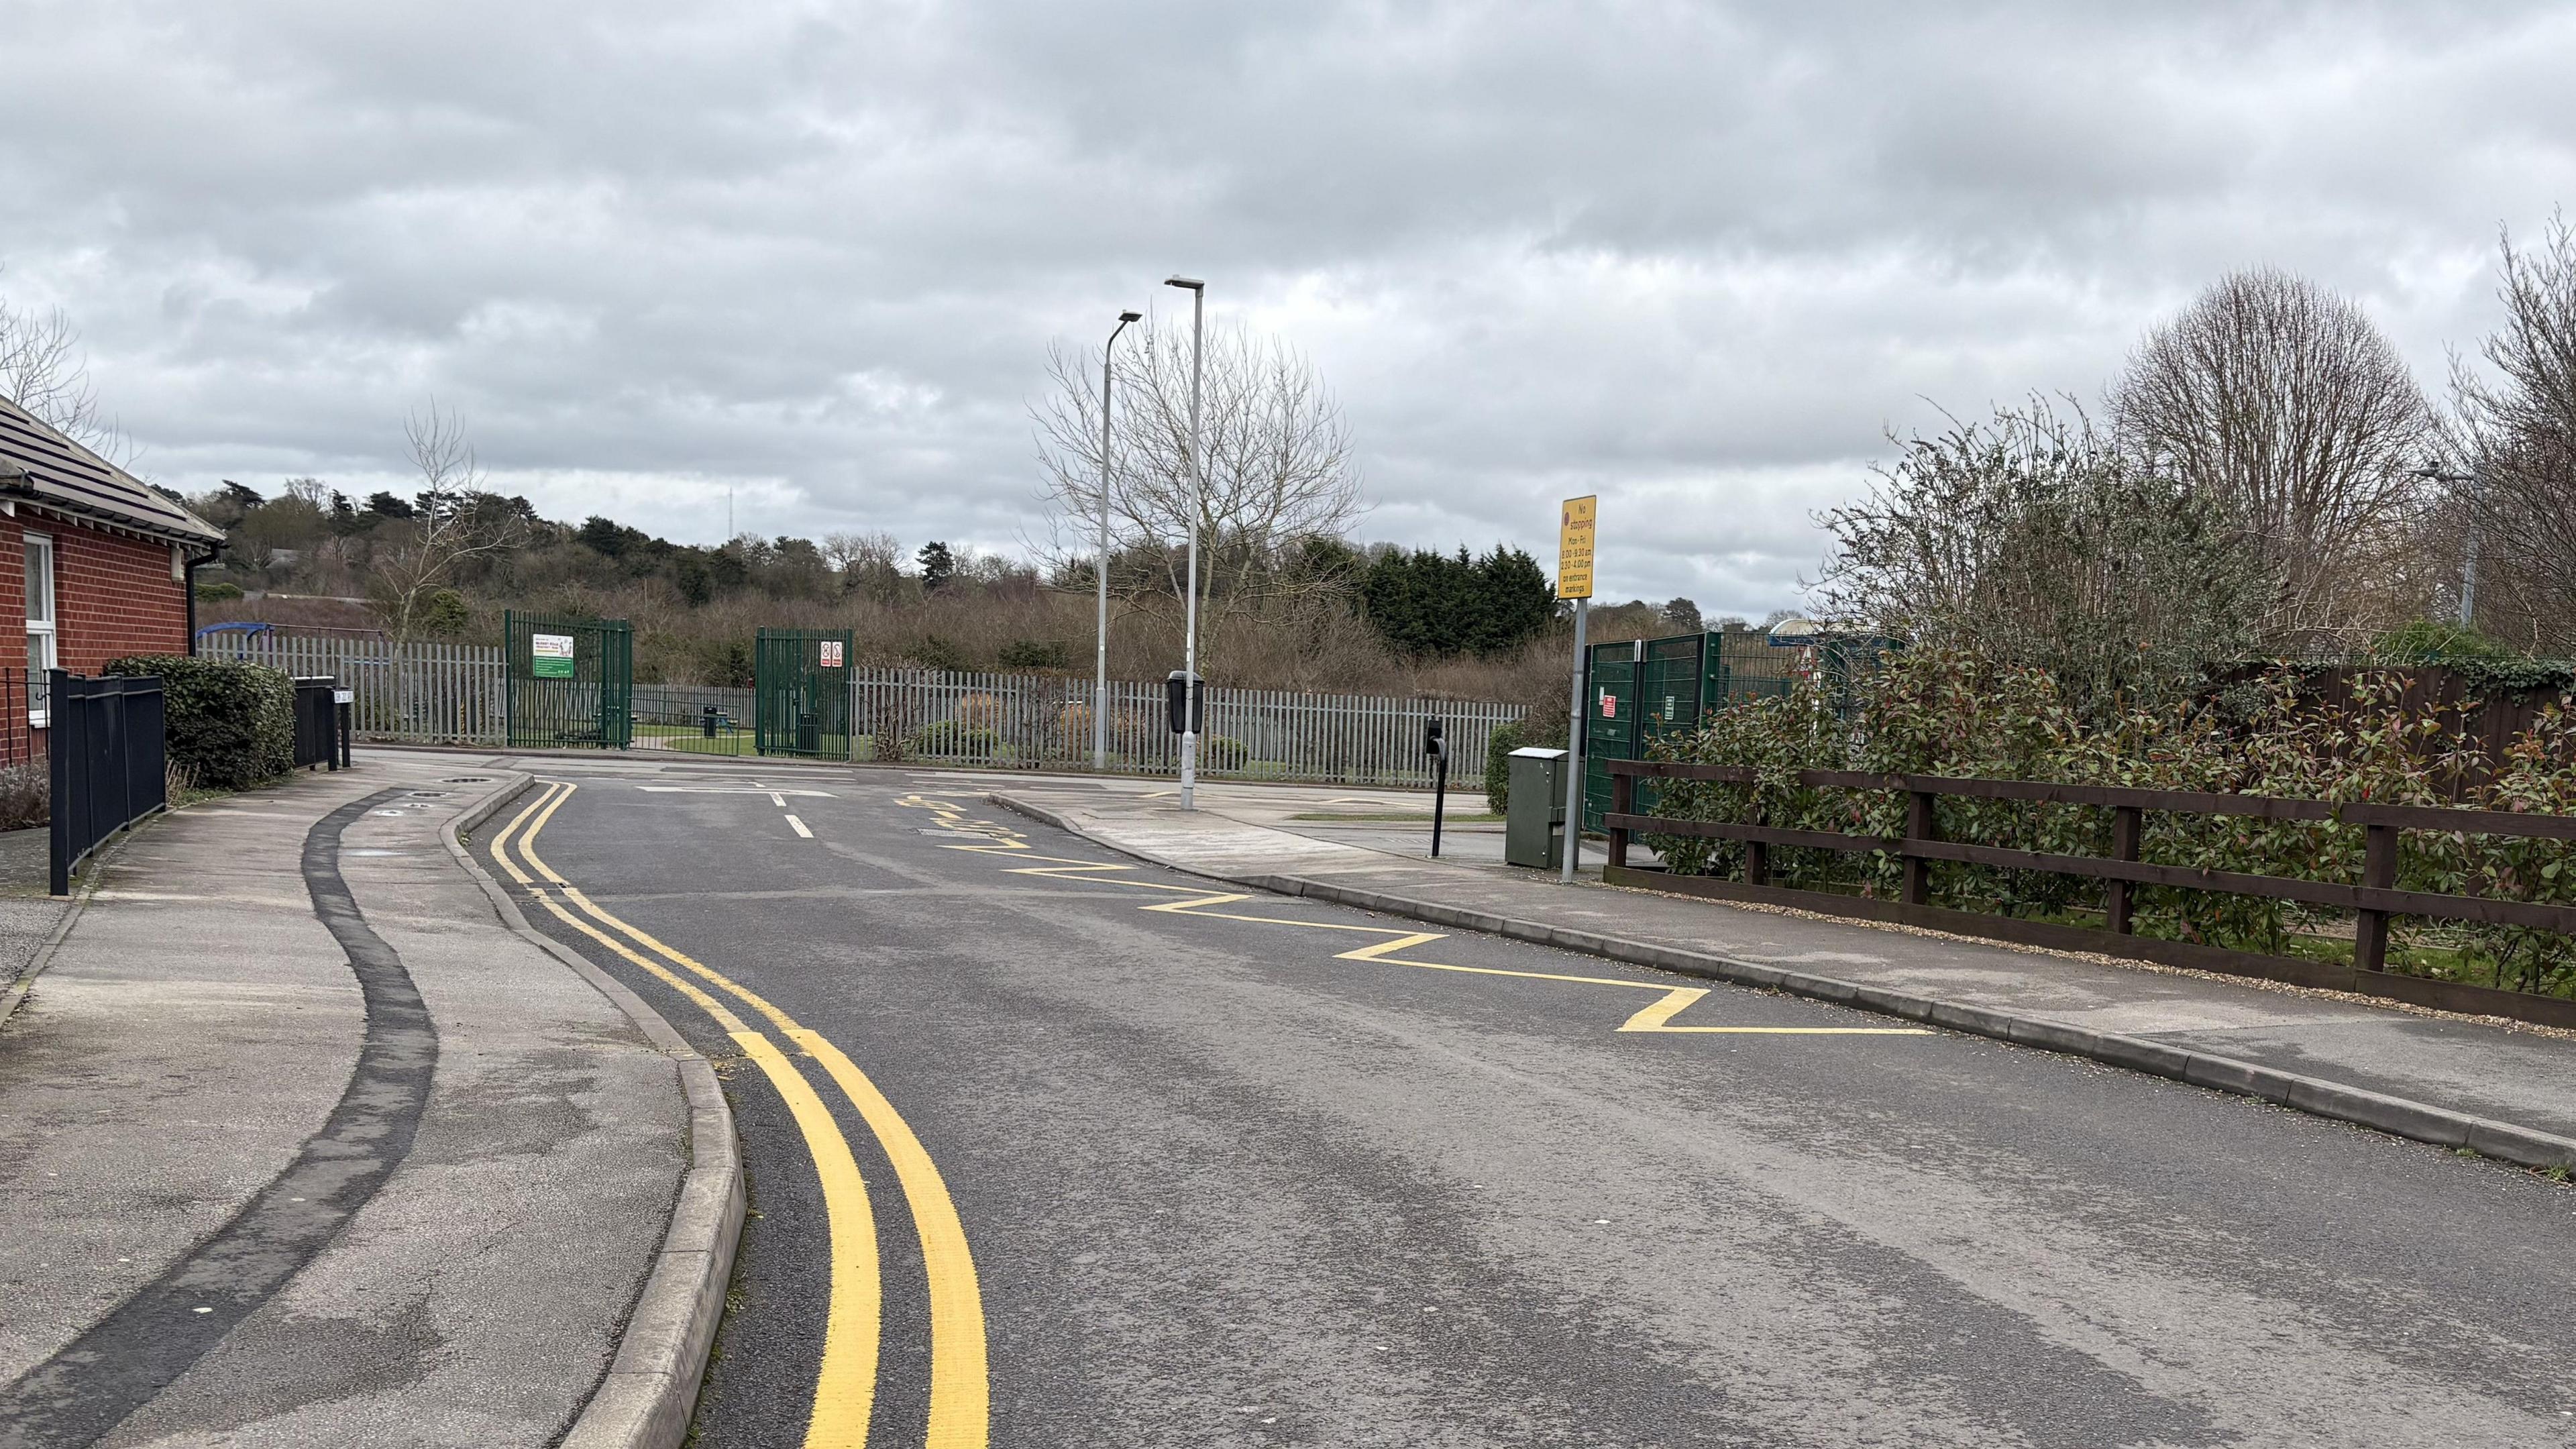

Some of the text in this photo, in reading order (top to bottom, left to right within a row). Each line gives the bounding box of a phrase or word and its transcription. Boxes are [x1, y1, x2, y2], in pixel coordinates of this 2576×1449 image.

[1578, 504, 1586, 514] No
[1570, 517, 1592, 531] stopping
[1585, 561, 1591, 569] pm
[1569, 574, 1587, 582] entrance
[1565, 584, 1584, 594] markings
